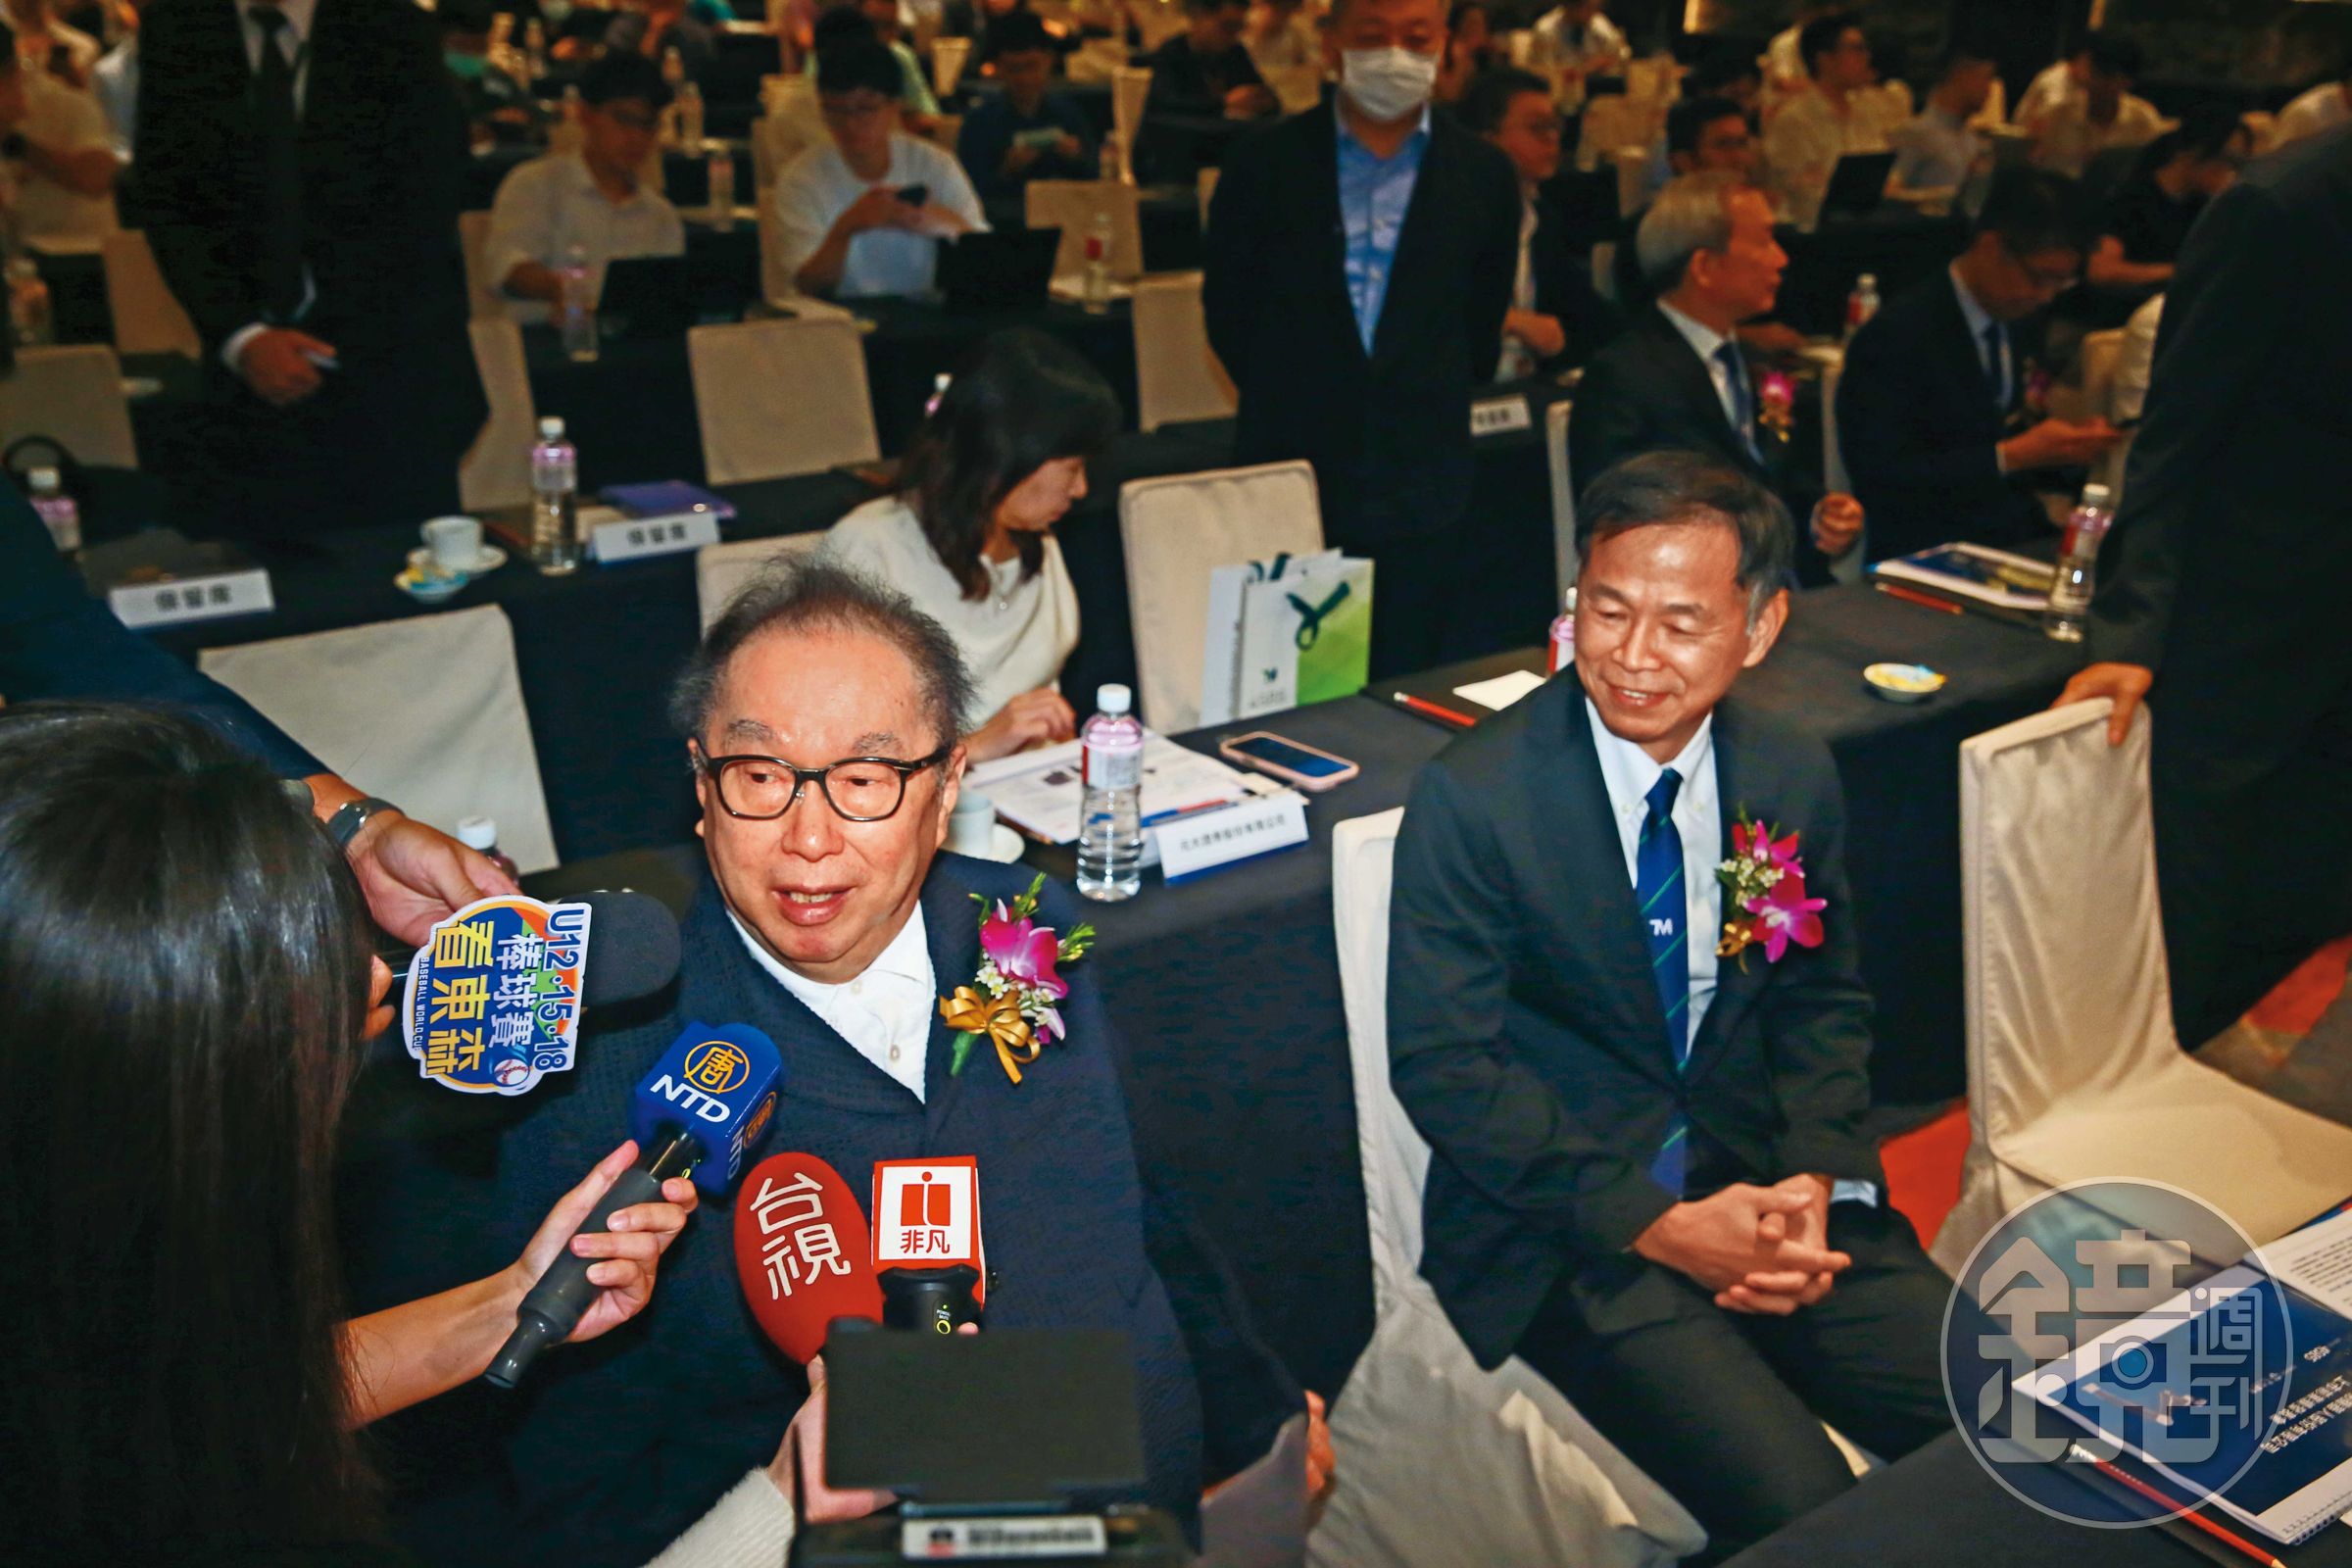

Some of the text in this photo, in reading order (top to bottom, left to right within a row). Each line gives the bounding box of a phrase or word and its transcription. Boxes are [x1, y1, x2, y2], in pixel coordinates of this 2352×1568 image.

[417, 956, 430, 1002] BASEBALL
[425, 920, 495, 1076] 看東森
[488, 933, 544, 1049] 棒球賽
[416, 1004, 426, 1036] WORLD
[650, 1074, 731, 1123] NTD
[750, 1172, 852, 1300] 台視
[900, 1229, 951, 1254] 非凡
